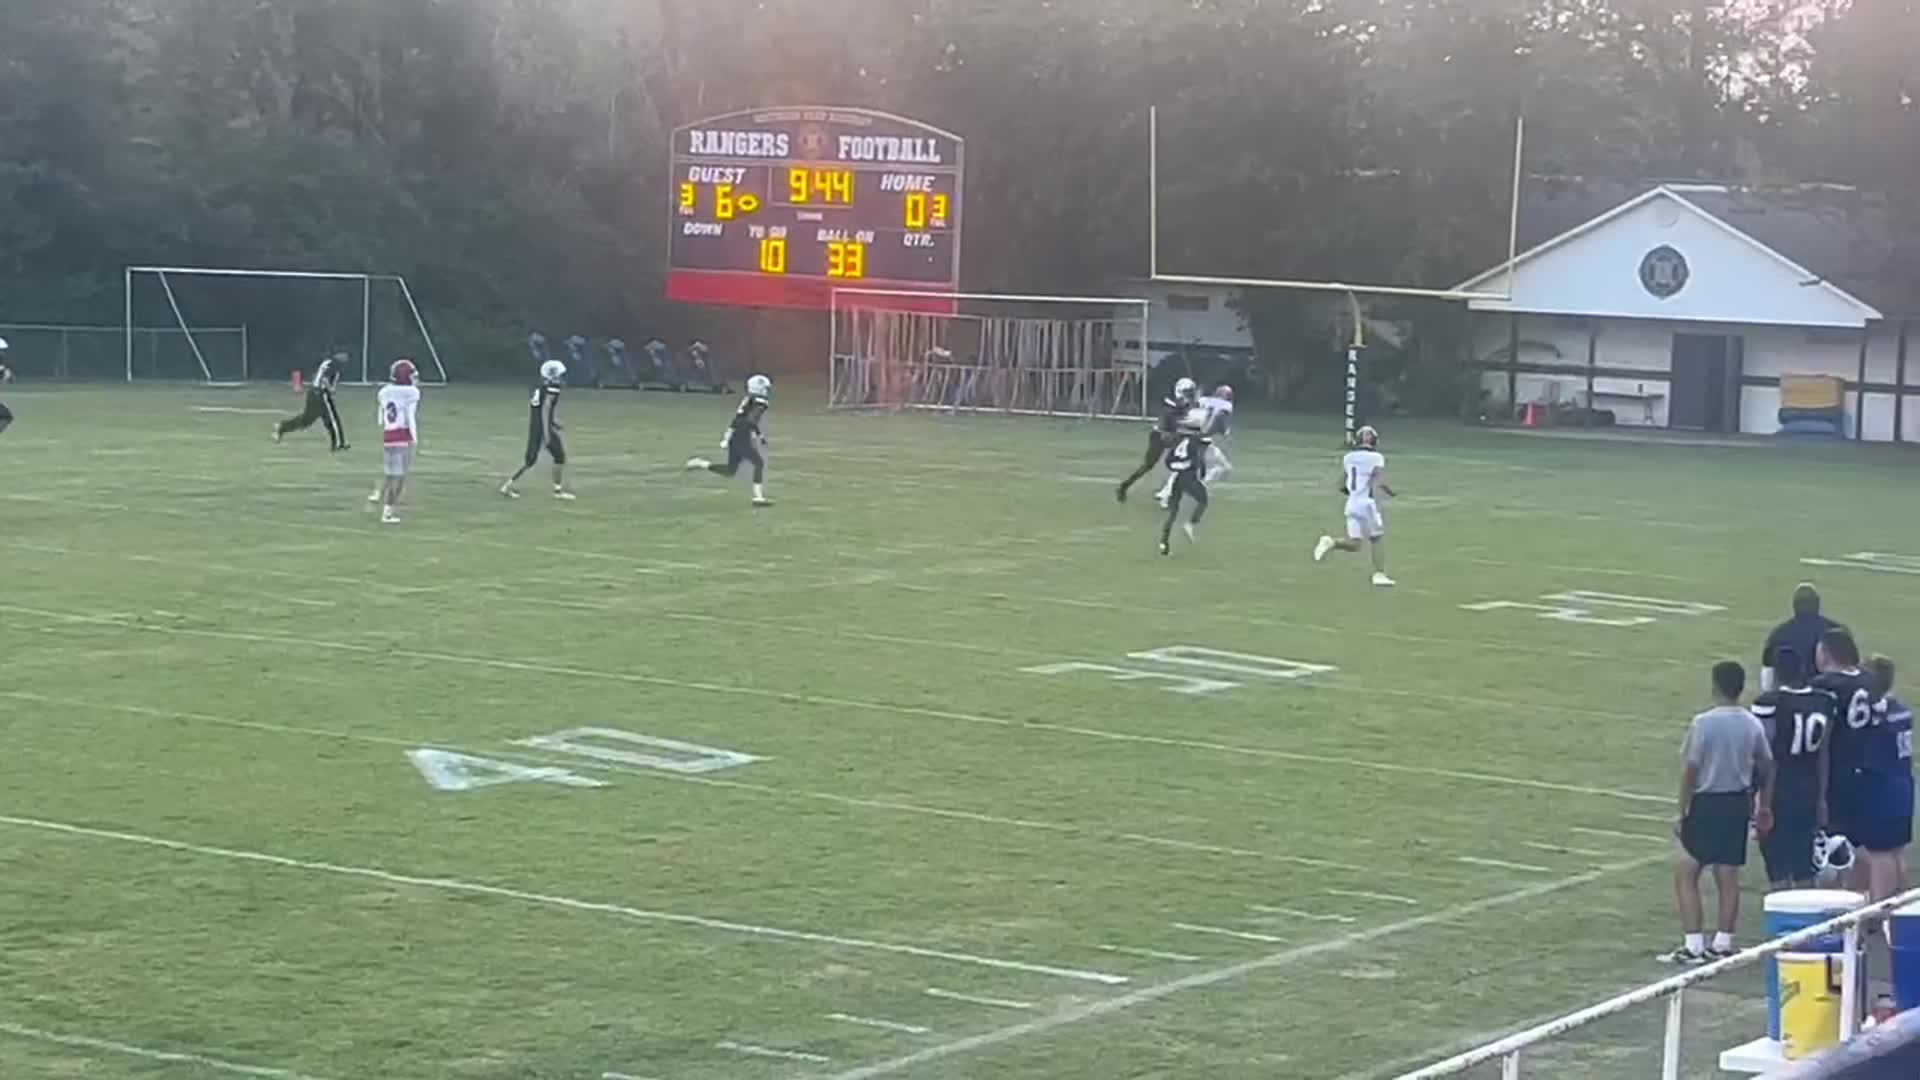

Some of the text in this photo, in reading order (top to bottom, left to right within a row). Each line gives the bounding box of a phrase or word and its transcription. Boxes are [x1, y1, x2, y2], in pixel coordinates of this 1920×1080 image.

[689, 130, 941, 162] RANGERS FOOTBALL
[688, 166, 746, 184] GUEST
[881, 174, 936, 192] HOME
[680, 183, 694, 207] 3
[715, 184, 734, 218] 6
[932, 194, 947, 217] 3
[905, 193, 925, 228] 0
[683, 221, 723, 236] DOWN
[816, 228, 848, 243] BALL
[760, 239, 785, 273] 10
[827, 242, 864, 277] 33
[1174, 436, 1190, 458] 4
[1790, 712, 1827, 755] 10
